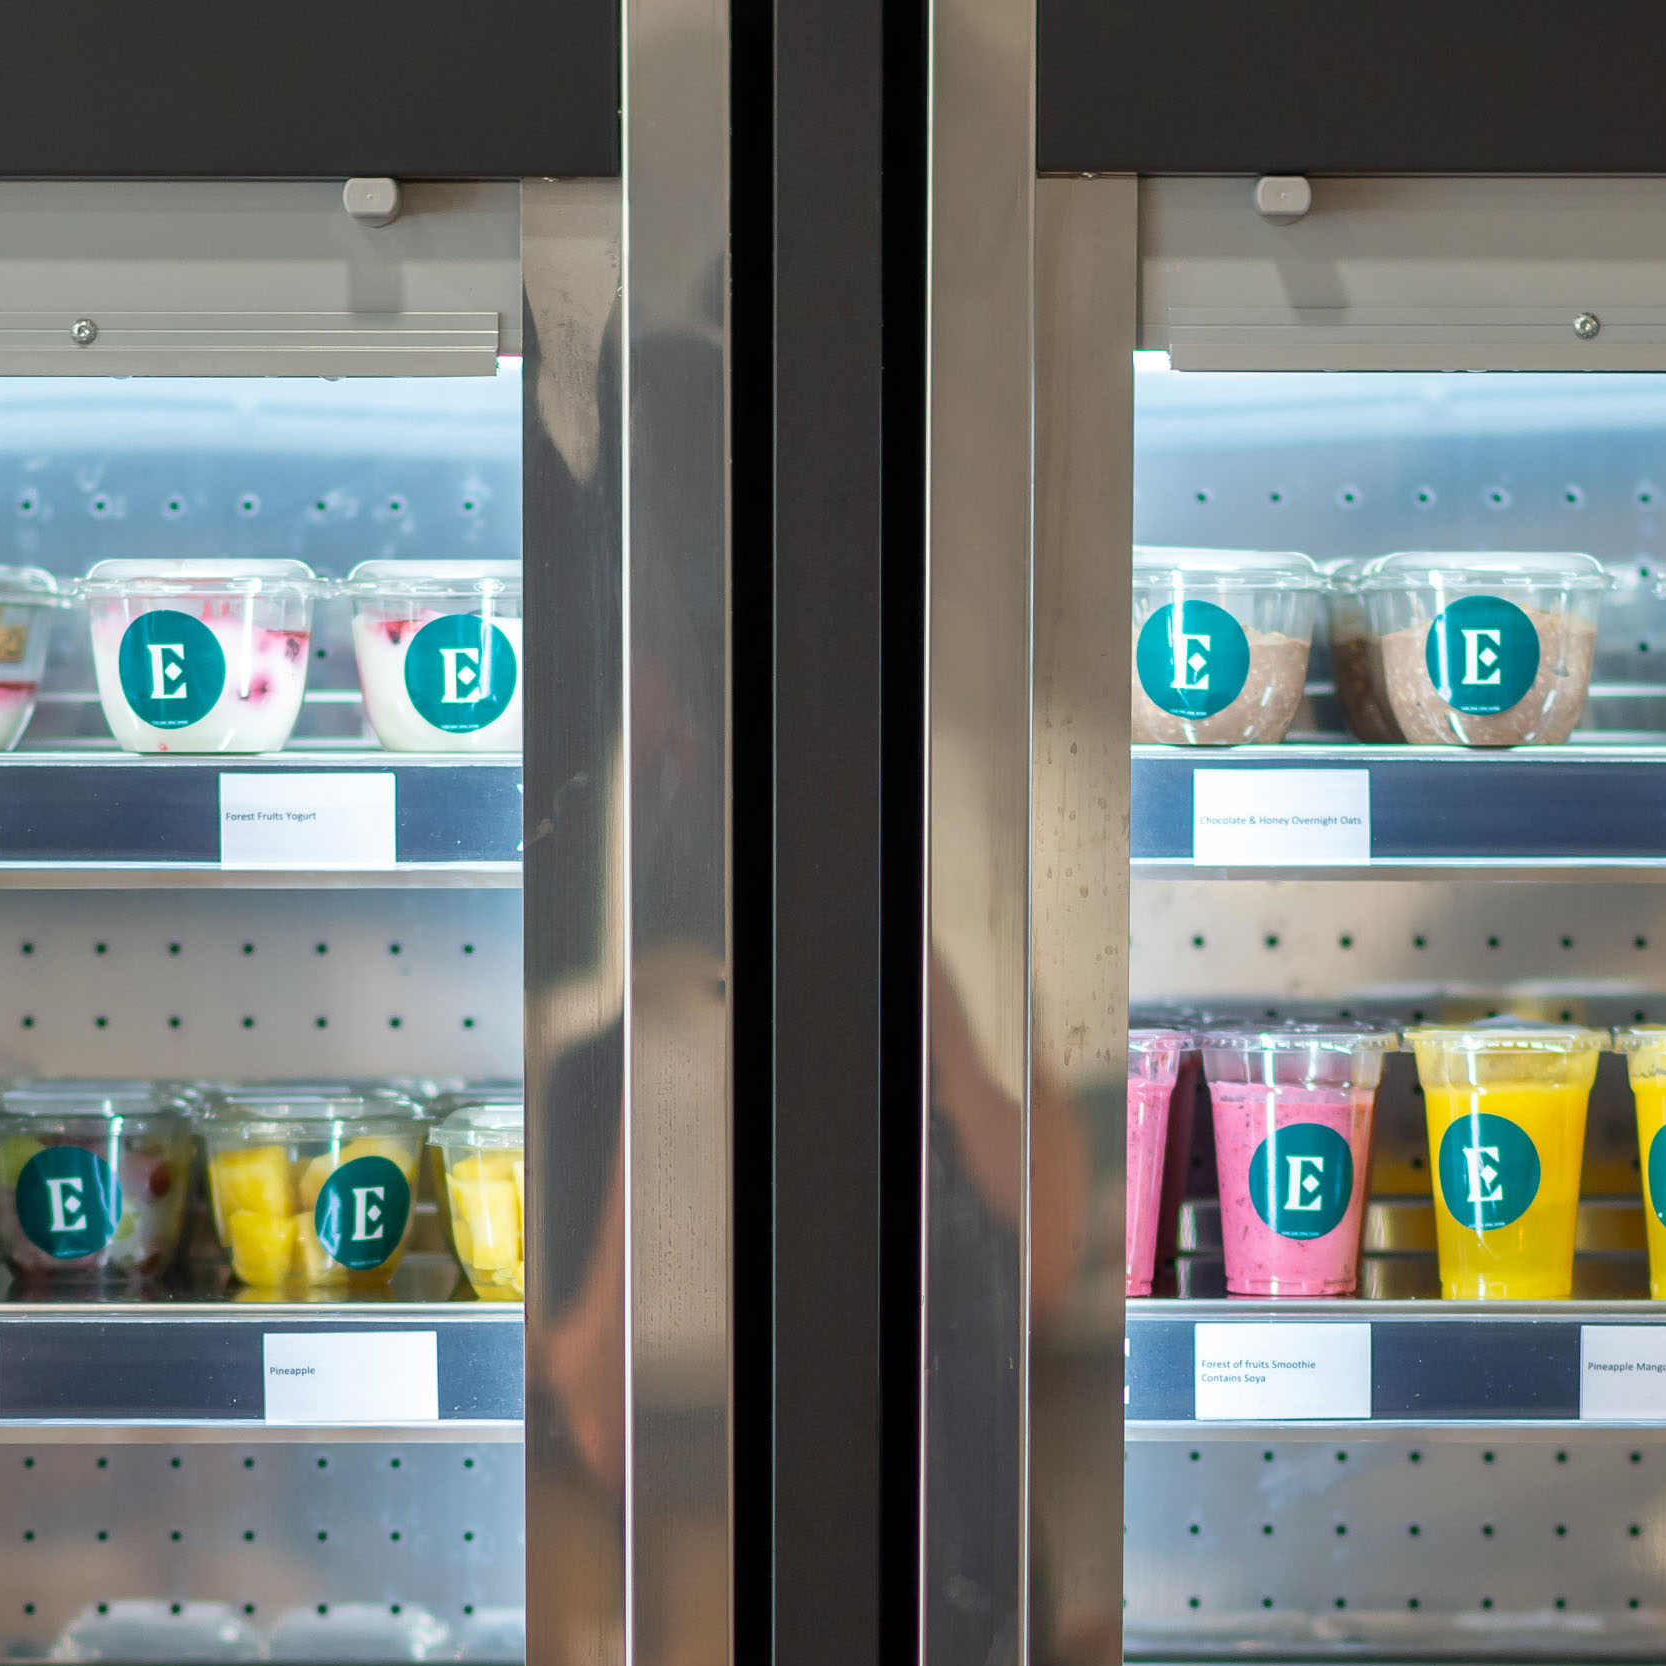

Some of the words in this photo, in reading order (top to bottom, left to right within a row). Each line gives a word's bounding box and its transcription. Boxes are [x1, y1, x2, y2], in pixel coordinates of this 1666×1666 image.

[1461, 629, 1501, 685] E
[147, 644, 188, 699] E
[225, 811, 256, 821] Forest
[256, 811, 285, 821] Fruits
[285, 811, 317, 823] Yogurt
[1201, 1359, 1231, 1369] Forest
[1232, 1359, 1244, 1369] of
[1244, 1359, 1270, 1369] fruits
[1271, 1359, 1317, 1369] Smoothie
[1587, 1361, 1635, 1373] Pineapple
[269, 1365, 316, 1377] Pineapple
[1201, 1373, 1243, 1383] Contains
[1244, 1373, 1267, 1385] Soya
